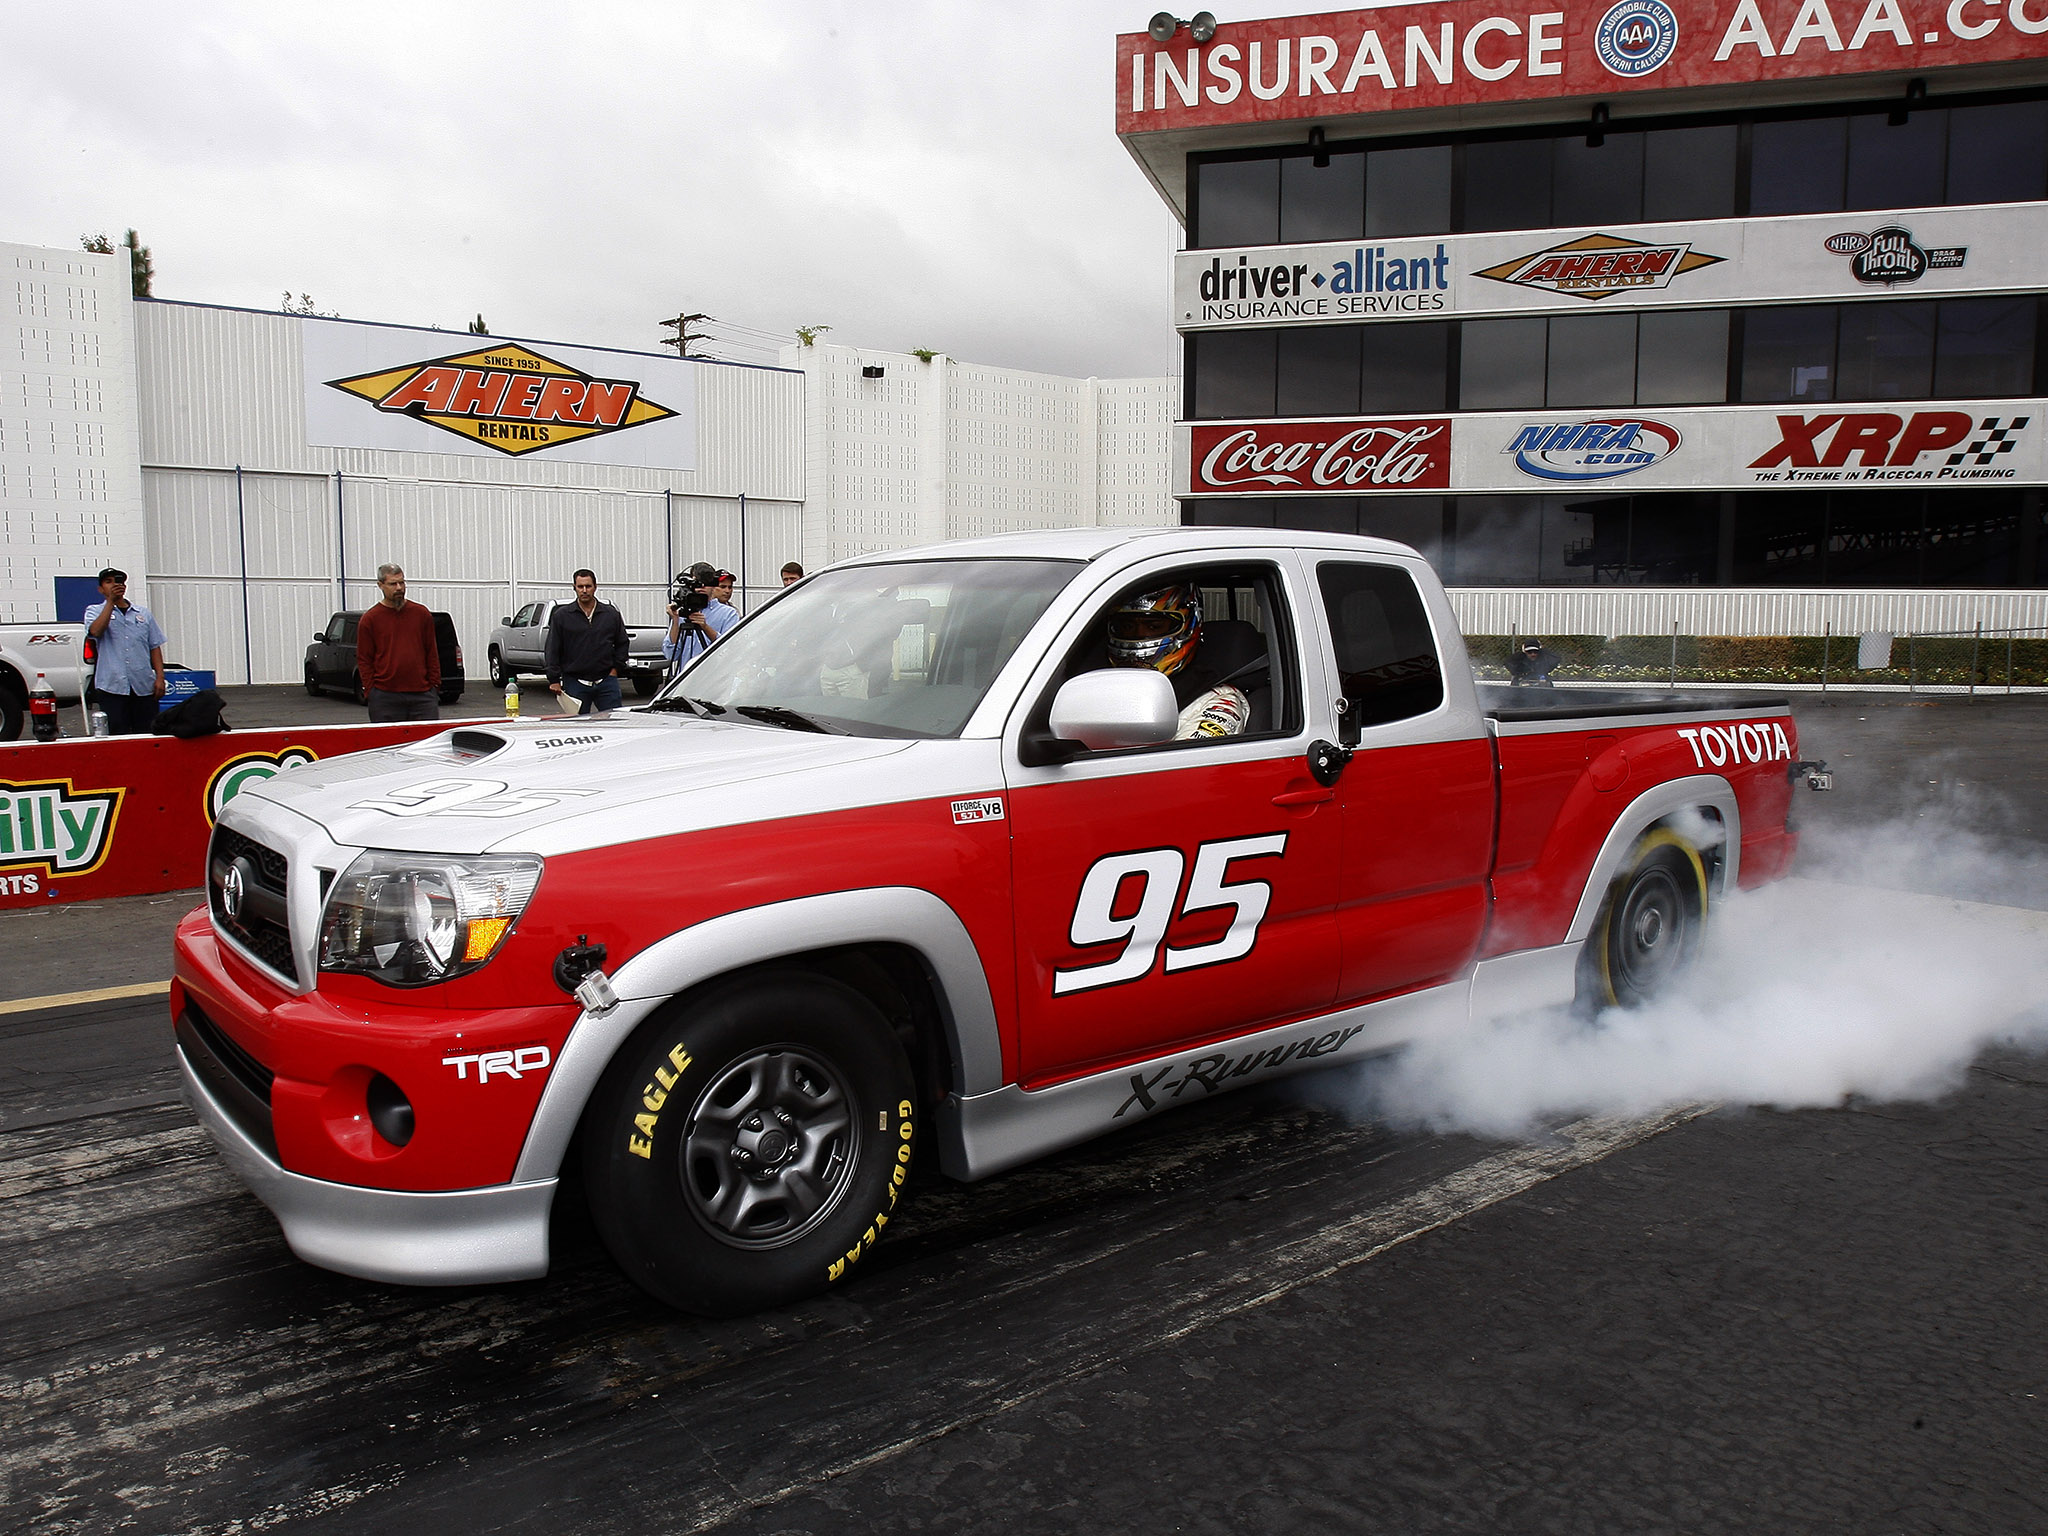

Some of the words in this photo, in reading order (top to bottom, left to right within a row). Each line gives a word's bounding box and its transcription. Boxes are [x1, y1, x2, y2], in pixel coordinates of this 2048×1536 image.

[1604, 2, 1654, 32] AUTOMOBILE
[1652, 6, 1671, 26] CLUB
[1601, 36, 1632, 71] SOUTHERN
[1634, 30, 1673, 71] CALIFORNIA
[1619, 25, 1653, 45] AAA
[1132, 12, 1564, 112] INSURANCE
[1831, 236, 1864, 250] NHRA
[1200, 256, 1307, 302] driver
[1330, 244, 1449, 294] alliant
[1519, 250, 1677, 281] AHERN
[1556, 275, 1655, 290] RENTALS
[1203, 298, 1328, 320] INSURANCE
[1337, 293, 1444, 314] SERVICES
[484, 355, 514, 367] SINCE
[516, 359, 541, 370] 1953
[378, 366, 634, 426] AHERN
[478, 423, 549, 441] RENTALS
[1507, 423, 1642, 451] NHRA
[1746, 411, 1973, 468] XRP
[1200, 425, 1444, 486] Coca-Cola
[1575, 453, 1656, 464] .com
[1754, 472, 1781, 482] THE
[1844, 471, 1861, 481] IN
[535, 735, 603, 749] 504HP
[1677, 722, 1791, 768] TOYOTA
[346, 778, 605, 818] 95
[982, 803, 1001, 815] V8
[1052, 831, 1289, 997] 95
[442, 1046, 550, 1084] TRD
[1111, 1023, 1365, 1119] X-Runner
[628, 1042, 693, 1160] EAGLE
